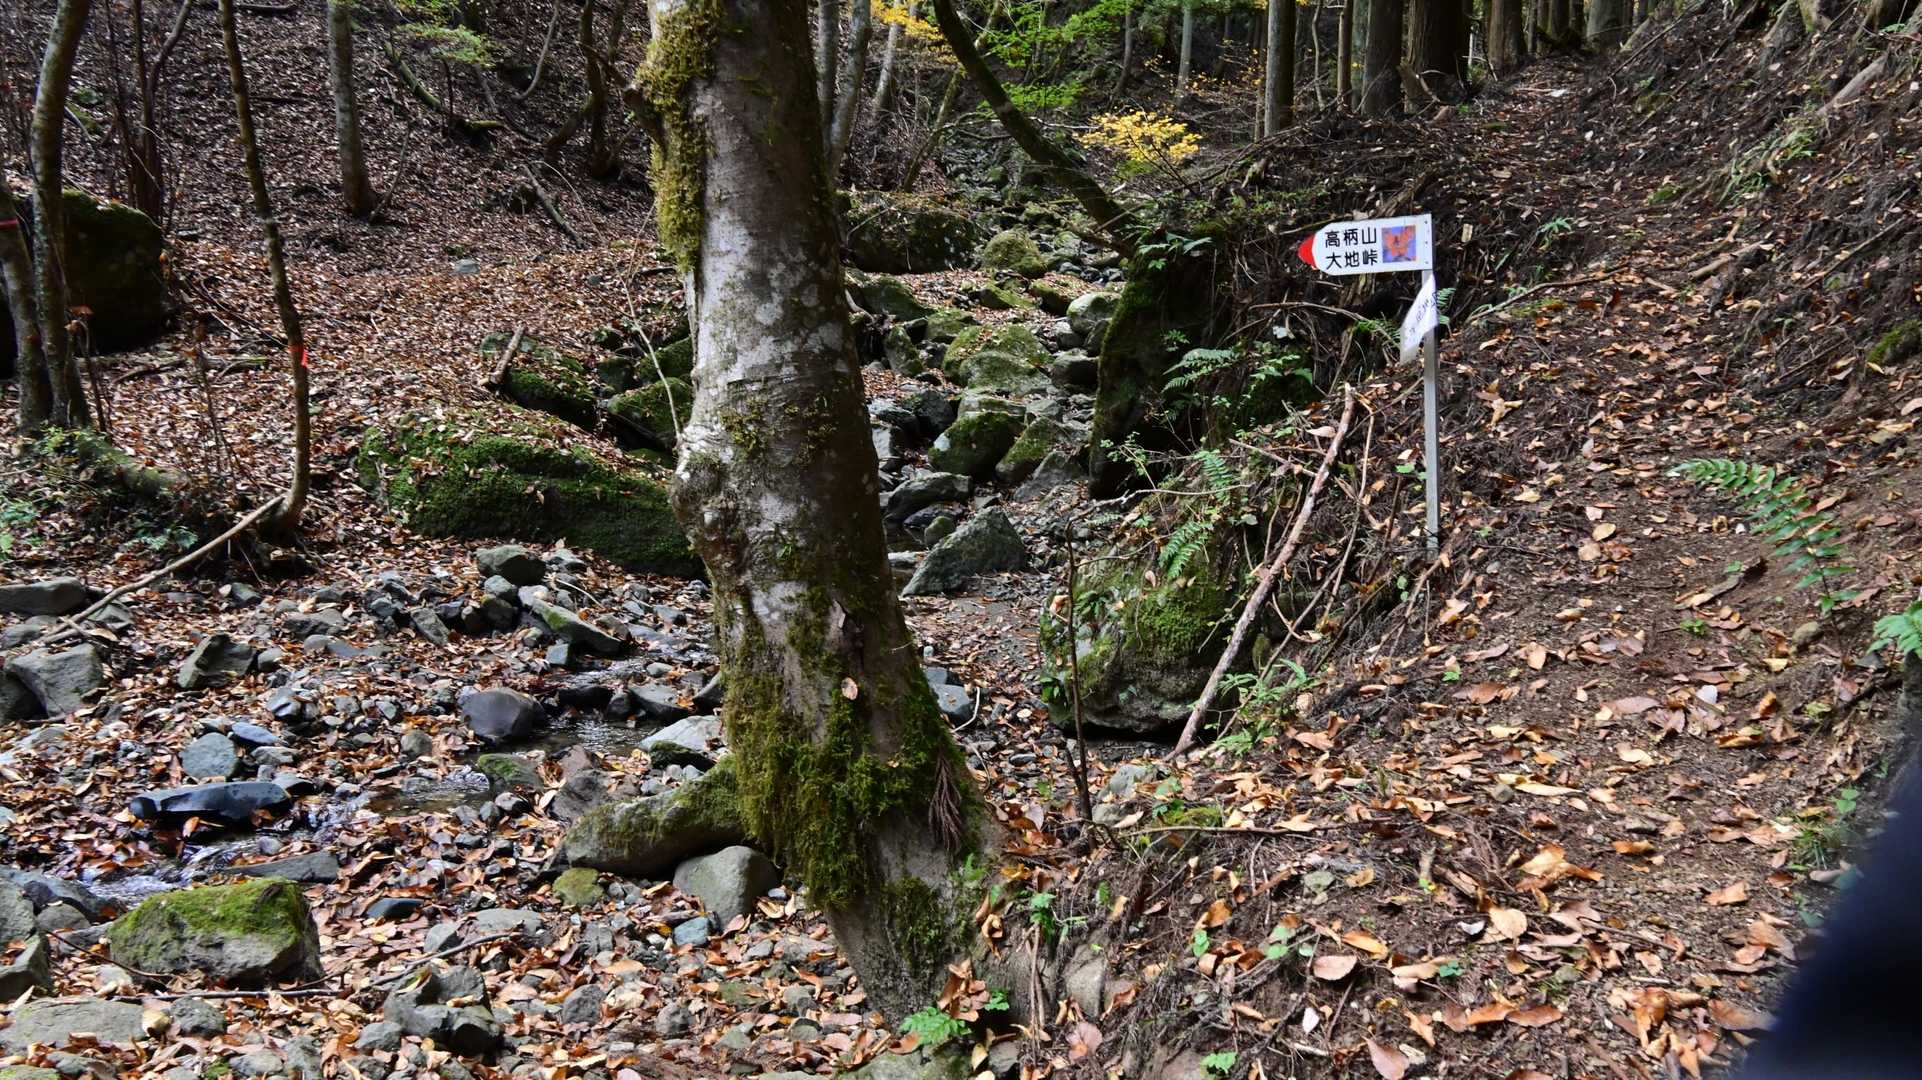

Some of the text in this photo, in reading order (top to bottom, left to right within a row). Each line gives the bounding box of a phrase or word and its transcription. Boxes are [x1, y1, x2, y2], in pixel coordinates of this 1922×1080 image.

[1325, 227, 1377, 248] 高柄山
[1326, 249, 1378, 270] 大地峠
